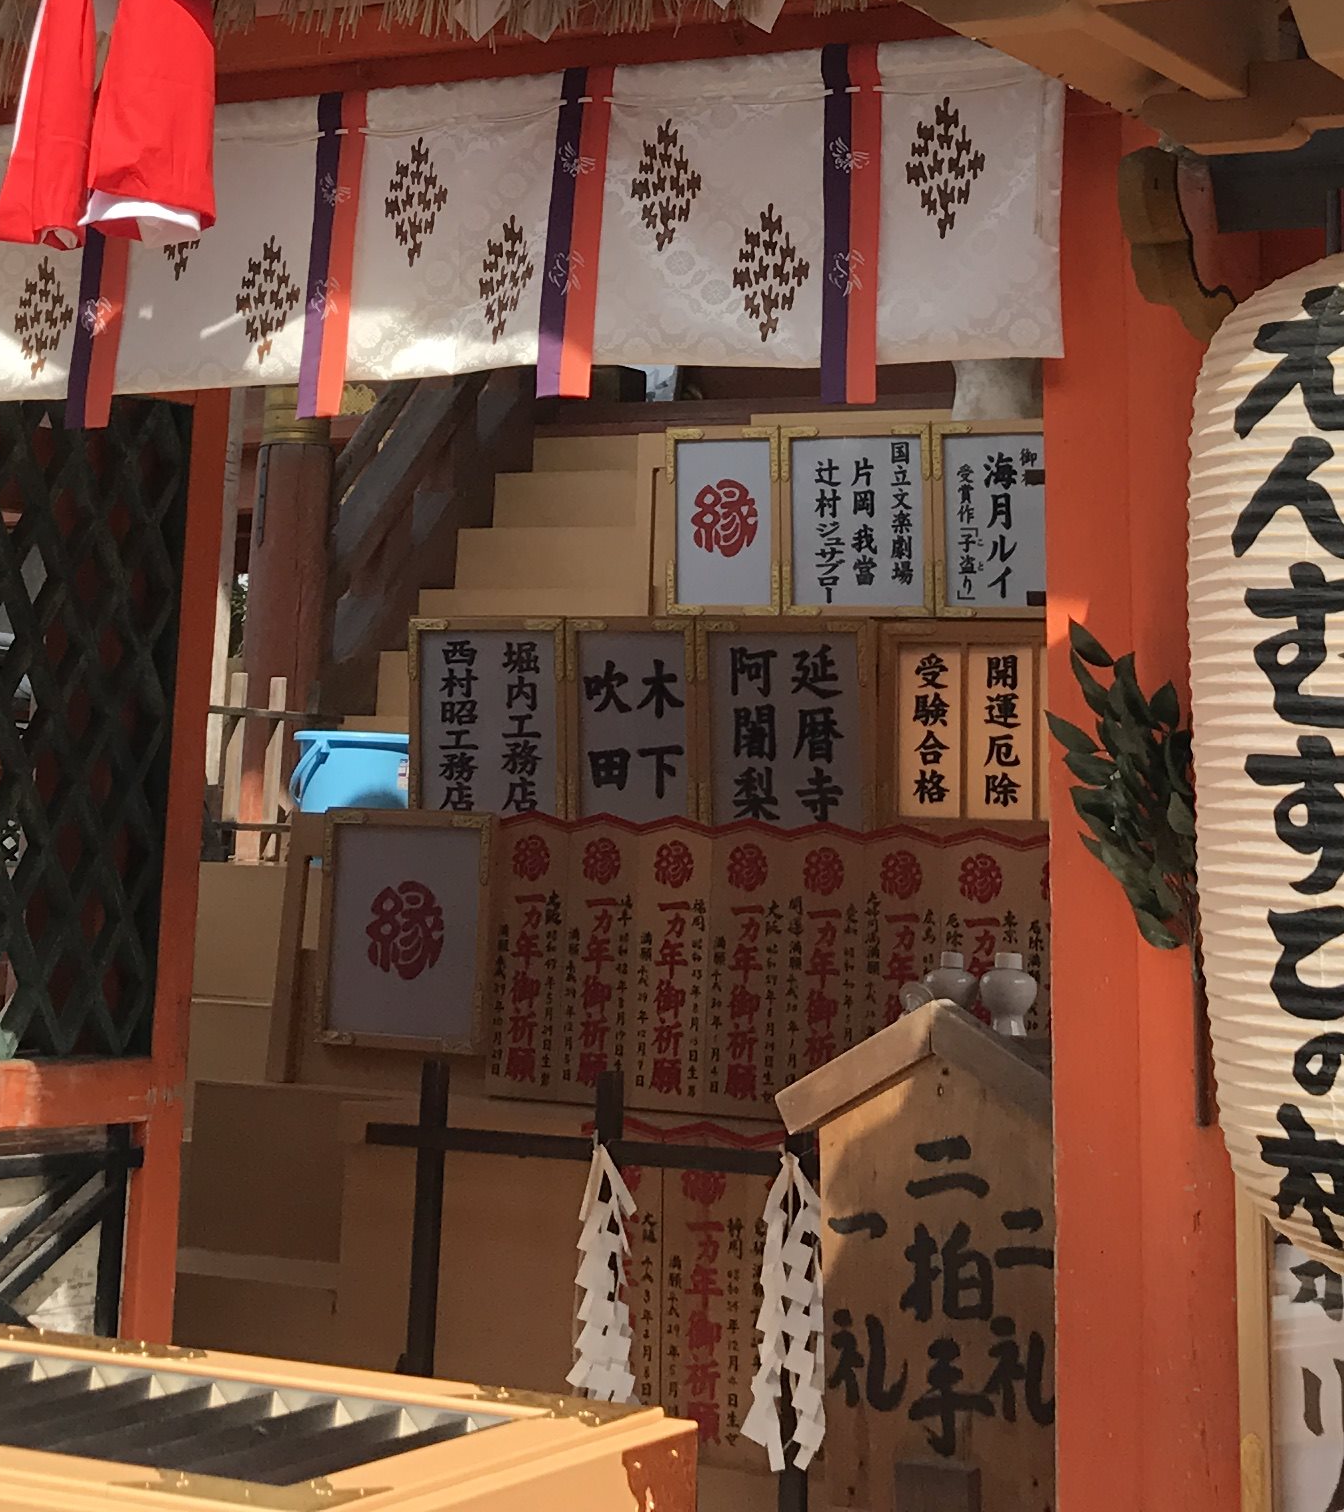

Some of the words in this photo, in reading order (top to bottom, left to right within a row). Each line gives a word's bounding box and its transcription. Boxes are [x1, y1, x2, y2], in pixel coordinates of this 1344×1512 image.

[815, 458, 845, 603] 辻村ジュサブロー
[891, 441, 914, 585] 国立文楽劇場
[983, 452, 1017, 598] 海月ルイ
[439, 640, 479, 811] 西村昭工務店
[501, 641, 542, 812] 堀内工務店
[583, 660, 632, 791] 吹田
[637, 659, 685, 799] 木下
[791, 644, 844, 822] 延暦寺
[913, 652, 950, 805] 受験合格
[984, 655, 1021, 807] 開運厄除
[828, 1211, 908, 1412] 一礼
[900, 1135, 995, 1457] 二拍手
